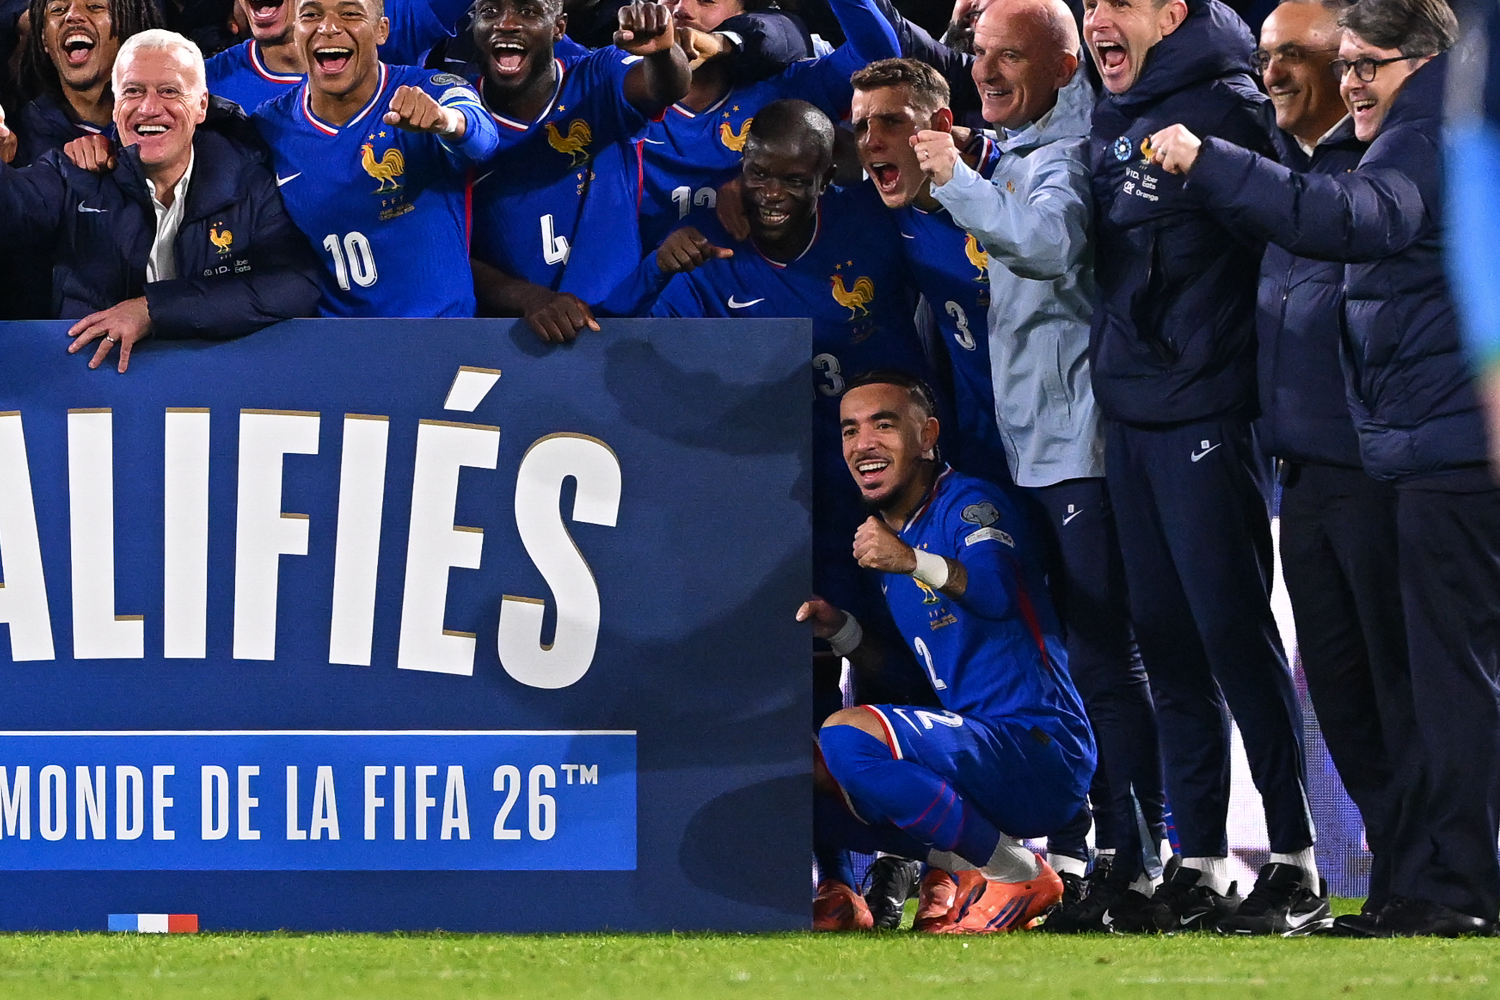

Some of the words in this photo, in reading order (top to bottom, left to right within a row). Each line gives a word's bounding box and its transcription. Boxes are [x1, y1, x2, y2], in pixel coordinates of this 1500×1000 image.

[1135, 189, 1159, 201] Orange
[322, 231, 378, 291] 10
[540, 213, 572, 266] 4
[944, 300, 977, 351] 3
[914, 636, 948, 691] 2
[201, 765, 261, 841] DE
[286, 765, 341, 841] LA
[364, 765, 471, 841] FIFA
